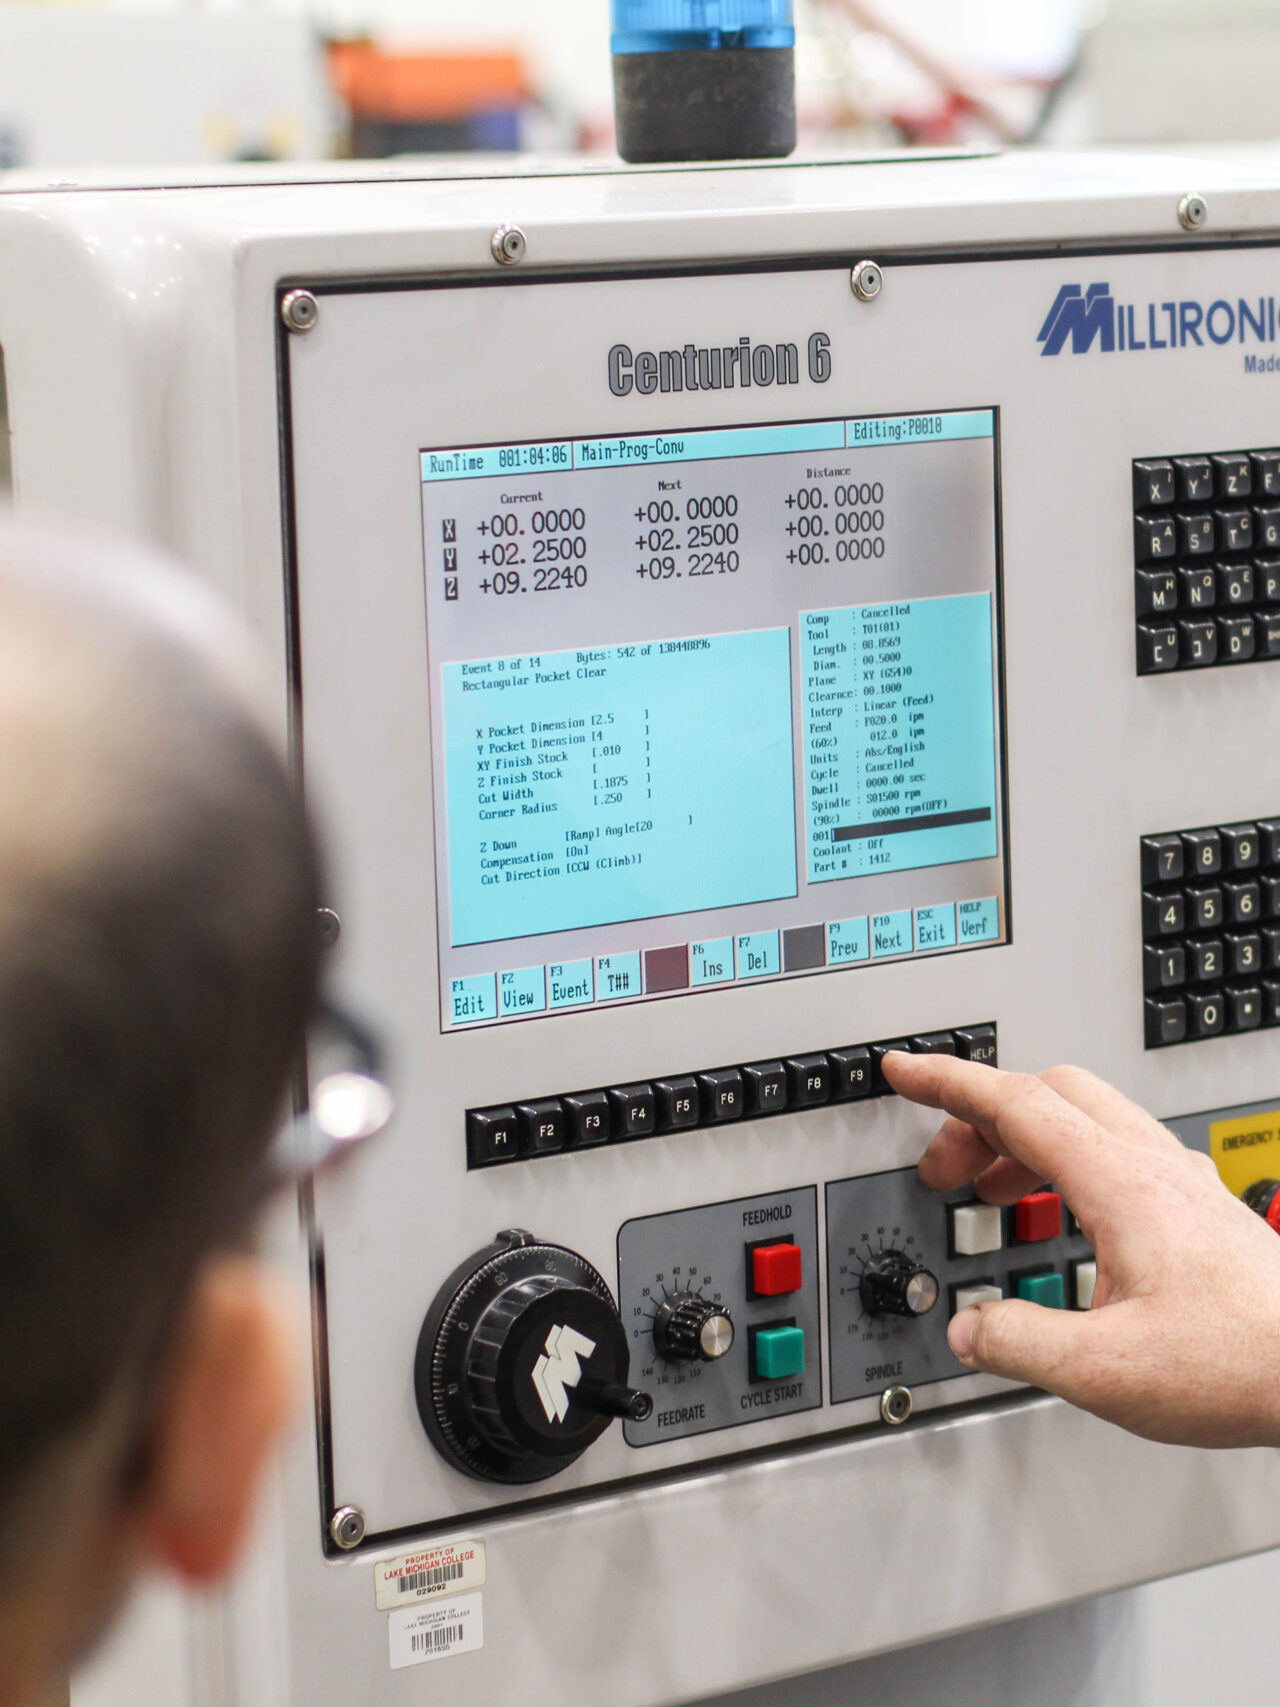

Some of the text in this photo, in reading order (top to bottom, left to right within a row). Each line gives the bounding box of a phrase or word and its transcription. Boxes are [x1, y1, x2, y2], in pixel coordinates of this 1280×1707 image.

[608, 332, 832, 397] Centurion 6
[581, 438, 685, 462] Main-Prog-Conv
[430, 446, 567, 473] RunTime 001:04:06
[806, 467, 851, 480] Distance
[1264, 472, 1273, 490] F
[658, 479, 682, 492] Next
[1151, 484, 1161, 500] X
[1189, 479, 1199, 496] Y
[1227, 476, 1238, 493] Z
[500, 491, 543, 505] Current
[443, 519, 456, 542] X
[1229, 529, 1238, 545] T
[1266, 526, 1277, 542] G
[1152, 537, 1161, 553] R
[1190, 533, 1199, 550] S
[444, 548, 457, 571] Y
[1191, 588, 1201, 604] N
[1230, 582, 1241, 599] O
[1267, 579, 1276, 597] P
[1153, 591, 1165, 606] M
[806, 605, 911, 625] Comp Cancelled
[808, 629, 829, 640] Tool
[813, 644, 847, 656] Length
[1230, 637, 1240, 653] D
[576, 649, 611, 665] Bytes:
[617, 647, 635, 659] 542
[641, 645, 652, 656] of
[462, 662, 492, 675] Event
[510, 659, 521, 669] of
[529, 657, 541, 668] 14
[462, 667, 607, 692] Rectangular Pocket Clear
[808, 671, 874, 687] Plane XY
[810, 694, 934, 719] Interp Linear (Feed)
[476, 718, 585, 739] X Pocket Dimension
[810, 722, 832, 733] Feed
[477, 734, 586, 755] Y Pocket Dimension
[810, 742, 925, 765] Units Abs/English
[477, 752, 568, 772] XY Finish Stock
[811, 758, 914, 782] Cycle Cancelled
[490, 774, 527, 787] Finish
[532, 769, 563, 781] Stock
[812, 784, 839, 795] Dwell
[909, 773, 926, 783] sec
[478, 788, 534, 804] Cut Width
[812, 798, 851, 812] Spindle
[904, 789, 921, 800] rpm
[479, 802, 558, 820] Corner Radius
[492, 839, 518, 851] Down
[813, 839, 884, 857] Coolant Off
[1239, 841, 1251, 860] 9
[480, 851, 554, 870] Compensation
[869, 853, 891, 865] 1412
[1164, 852, 1175, 871] 7
[1202, 847, 1213, 865] 8
[481, 874, 500, 885] Cut
[505, 866, 560, 882] Direction
[814, 862, 836, 873] Part
[959, 902, 981, 914] HELP
[1203, 899, 1214, 919] 5
[1240, 894, 1252, 913] 6
[873, 916, 890, 927] F10
[917, 909, 933, 920] ESC
[1164, 906, 1176, 925] 4
[829, 923, 841, 934] F9
[919, 924, 945, 944] Exit
[961, 917, 987, 937] Verf
[738, 937, 751, 949] F7
[831, 939, 858, 958] Prev
[875, 931, 902, 950] Next
[692, 944, 704, 956] F6
[1242, 946, 1253, 965] 3
[598, 958, 611, 970] F4
[703, 959, 723, 978] Ins
[748, 952, 767, 971] Del
[1168, 959, 1174, 976] 1
[1204, 952, 1215, 971] 2
[501, 973, 514, 985] F2
[550, 965, 563, 977] F3
[452, 980, 464, 992] F1
[553, 979, 589, 1001] Event
[454, 997, 484, 1017] Edit
[503, 990, 534, 1009] View
[1204, 1005, 1217, 1025] 0
[970, 1046, 995, 1061] HELP
[807, 1077, 821, 1090] F8
[850, 1070, 864, 1082] F9
[720, 1092, 734, 1105] F6
[764, 1084, 778, 1096] F7
[631, 1107, 646, 1120] F4
[676, 1100, 690, 1113] F5
[540, 1124, 554, 1137] F2
[586, 1116, 600, 1128] F3
[495, 1132, 507, 1144] F1
[1222, 1128, 1273, 1152] EMERGENCY
[742, 1204, 792, 1227] FEEDHOLD
[865, 1360, 903, 1382] SPINDLE
[740, 1383, 803, 1409] CYCLE START
[657, 1404, 706, 1428] FEEDRATE
[405, 1547, 455, 1565] PROPERTY OF
[384, 1550, 475, 1581] LAKE MICHIGAN COLLEGE
